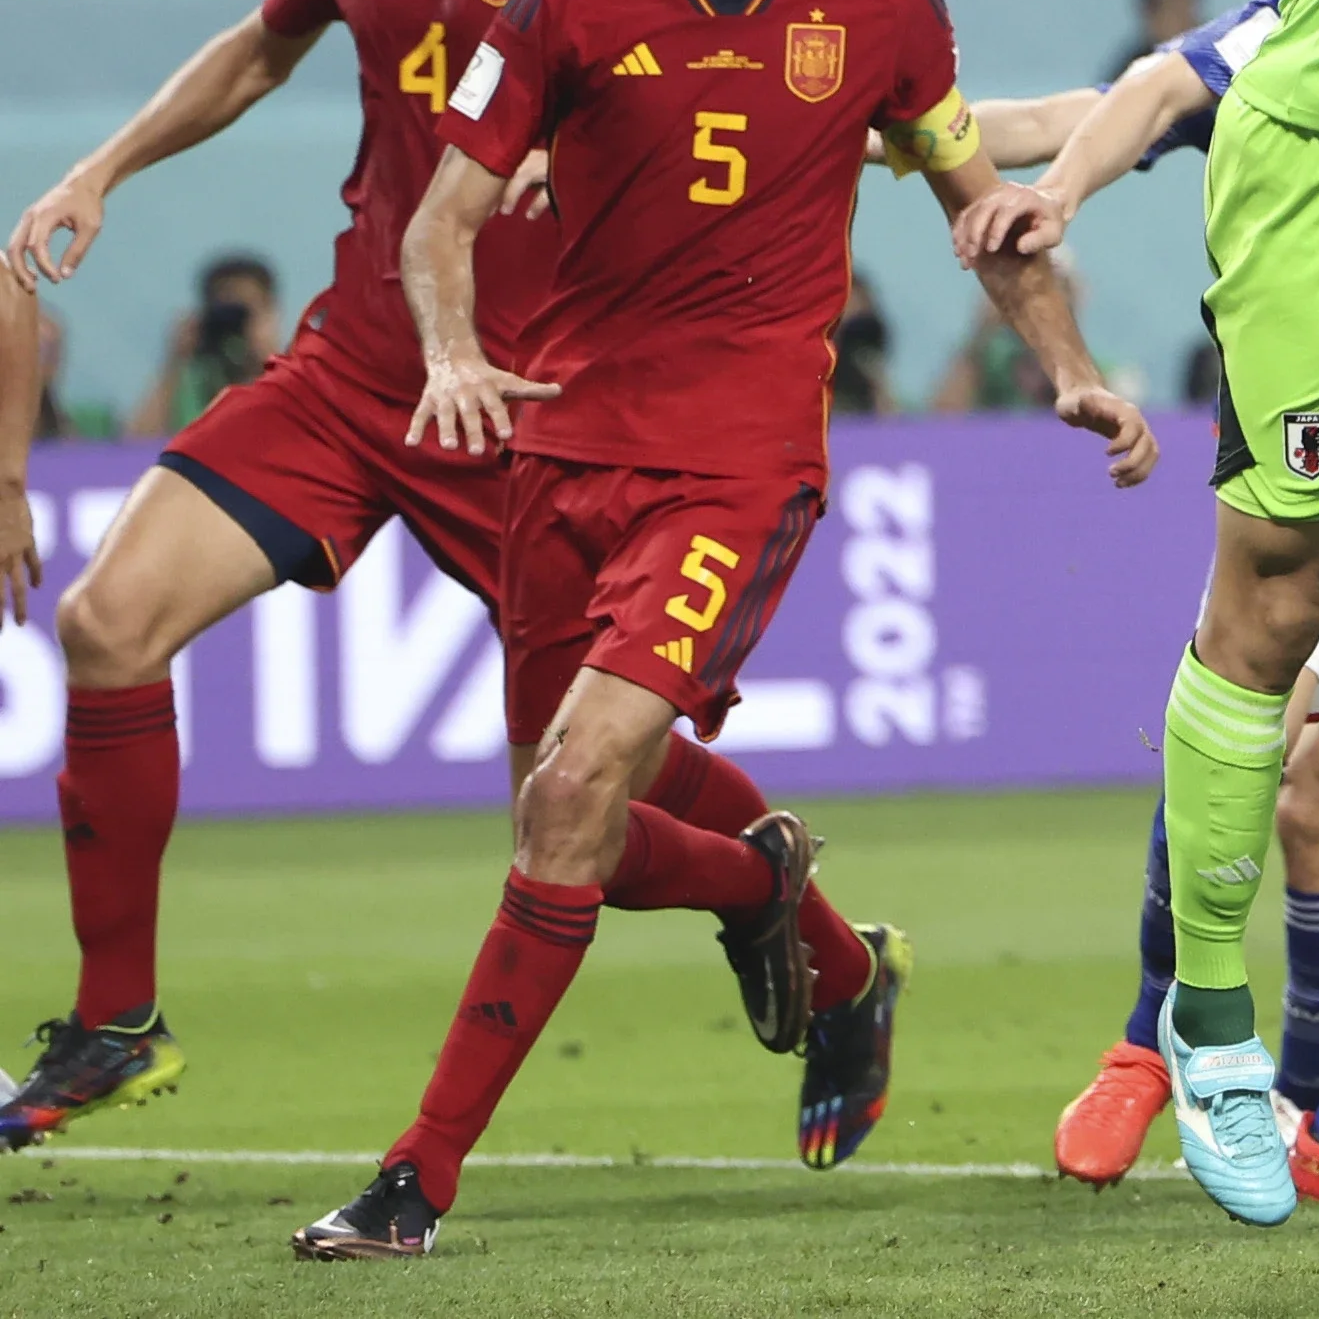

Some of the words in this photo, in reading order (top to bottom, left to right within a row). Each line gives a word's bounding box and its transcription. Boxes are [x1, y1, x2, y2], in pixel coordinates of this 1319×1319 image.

[399, 22, 447, 113] 4
[688, 113, 748, 206] 5
[664, 534, 741, 633] 5
[840, 461, 938, 747] 2022
